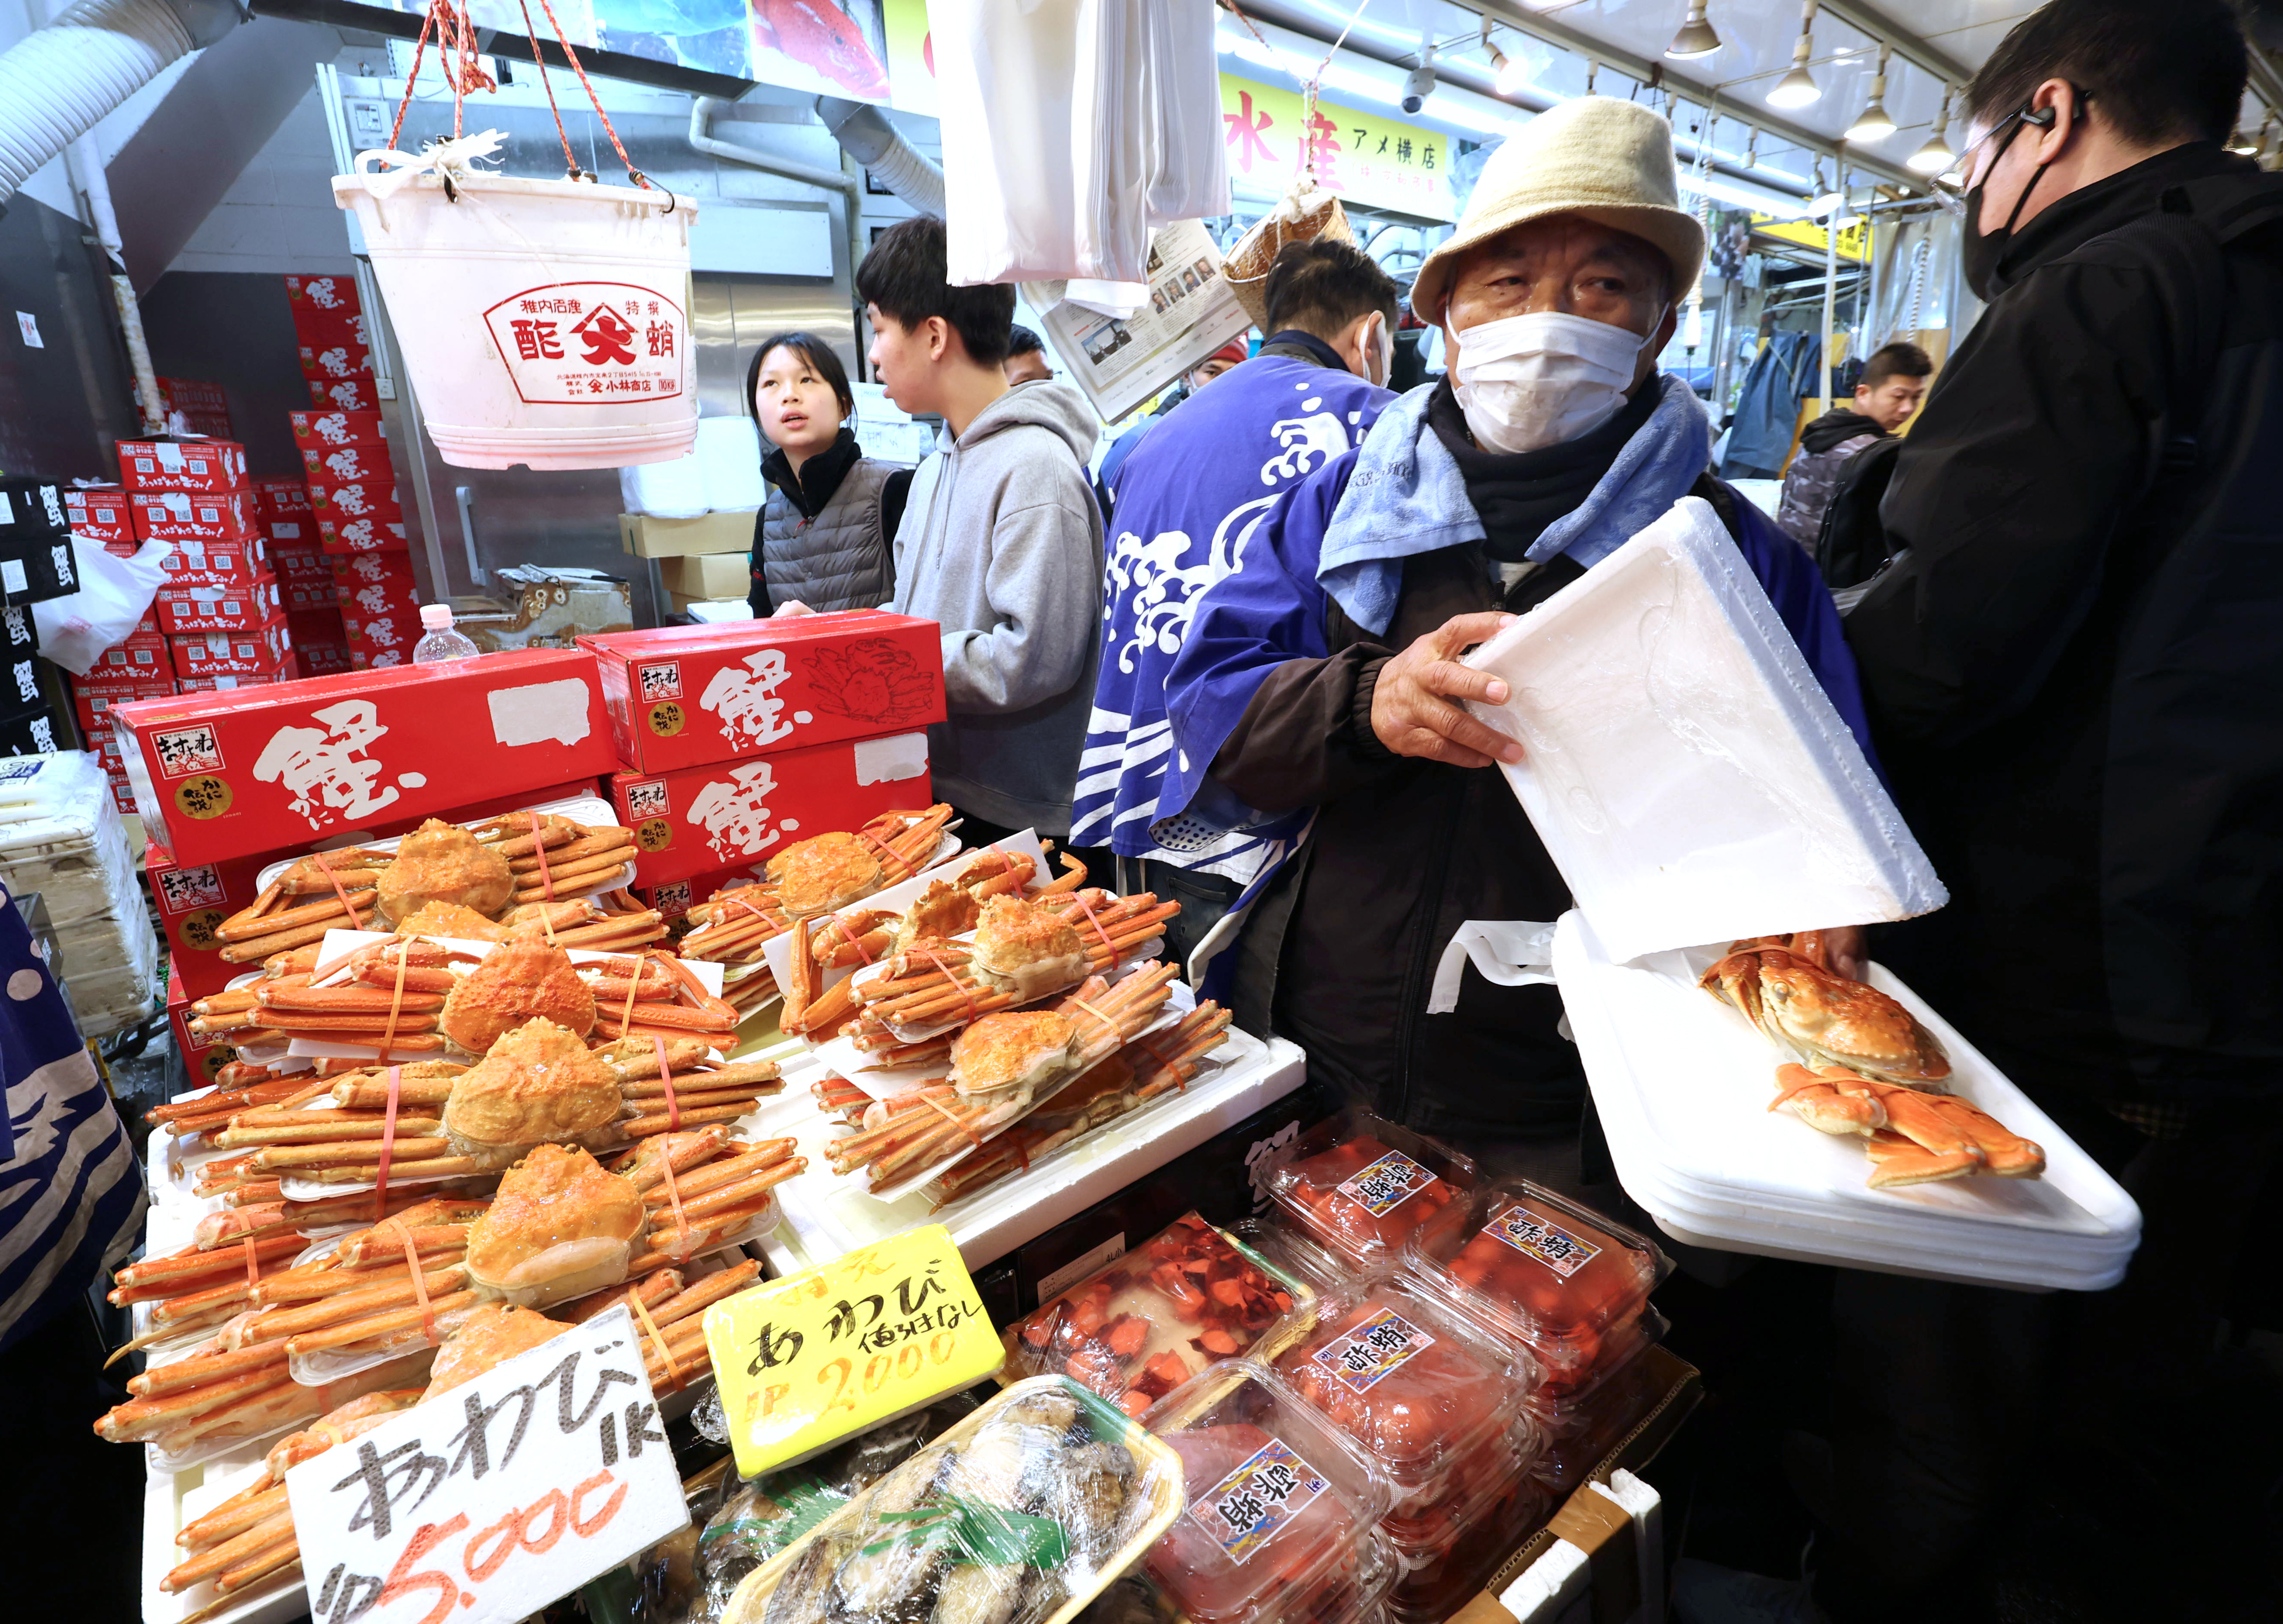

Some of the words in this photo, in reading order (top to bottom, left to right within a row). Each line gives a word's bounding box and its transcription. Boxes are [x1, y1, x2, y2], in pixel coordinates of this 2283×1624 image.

[1223, 90, 1345, 192] 水産
[1353, 129, 1435, 169] アメ横店
[646, 320, 674, 358] 蛸
[606, 379, 651, 392] 小林商店
[40, 484, 65, 527] 蟹
[51, 545, 74, 586] 蟹
[13, 660, 38, 702] 蟹
[699, 648, 813, 746] 蟹
[667, 705, 678, 721] かに
[253, 699, 427, 820] 蟹
[202, 780, 222, 800] かに
[686, 761, 800, 856] 蟹
[654, 822, 666, 837] かに
[1359, 1164, 1414, 1200] 酢蛸
[1508, 1219, 1574, 1259] 酢蛸
[747, 1259, 946, 1377] あわび
[1340, 1325, 1407, 1371] 酢蛸
[330, 1340, 637, 1540] あわび
[1219, 1465, 1298, 1533] 酢蛸
